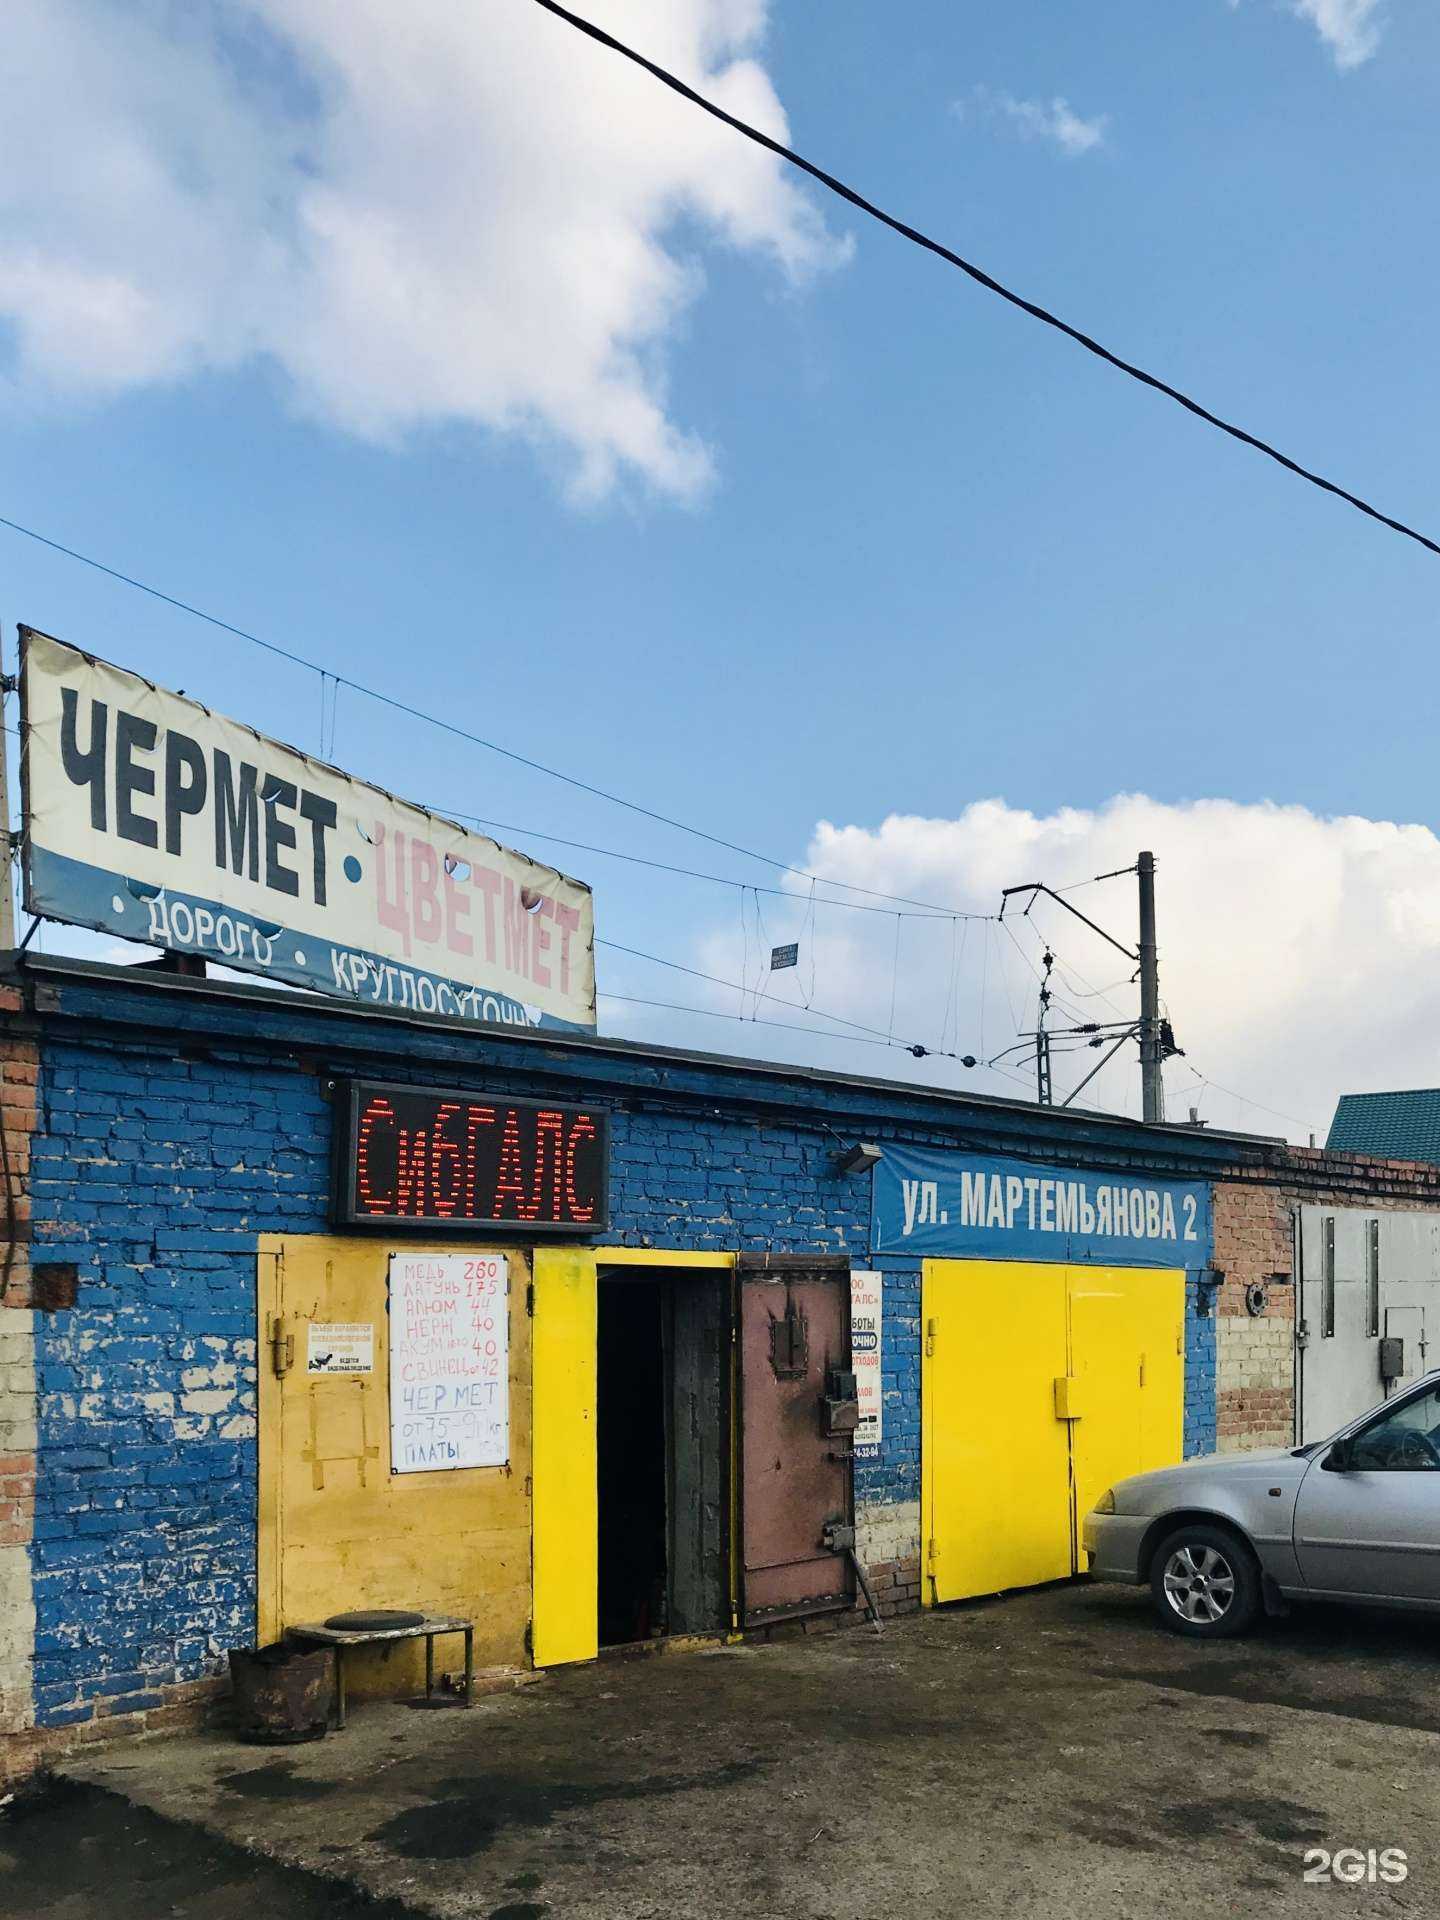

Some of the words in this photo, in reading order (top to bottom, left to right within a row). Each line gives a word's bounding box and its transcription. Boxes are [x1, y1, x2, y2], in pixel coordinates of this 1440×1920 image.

[60, 686, 337, 907] ЧЕРМЕТ
[374, 820, 581, 995] ЦВЕТМЕТ
[149, 899, 273, 966] ДОРОГО
[330, 948, 539, 1028] КРУГЛОСУТОЧН
[902, 1179, 948, 1236] ул.
[960, 1171, 1178, 1240] МАРТЕМЬЯНОВА
[1182, 1194, 1198, 1241] 2
[404, 1263, 446, 1280] МЕДЬ
[404, 1280, 461, 1298] ЛАТУНЬ
[465, 1280, 498, 1298] 175
[471, 1314, 494, 1333] 40
[472, 1336, 496, 1357] 40
[405, 1440, 460, 1466] ПЛАТЫ
